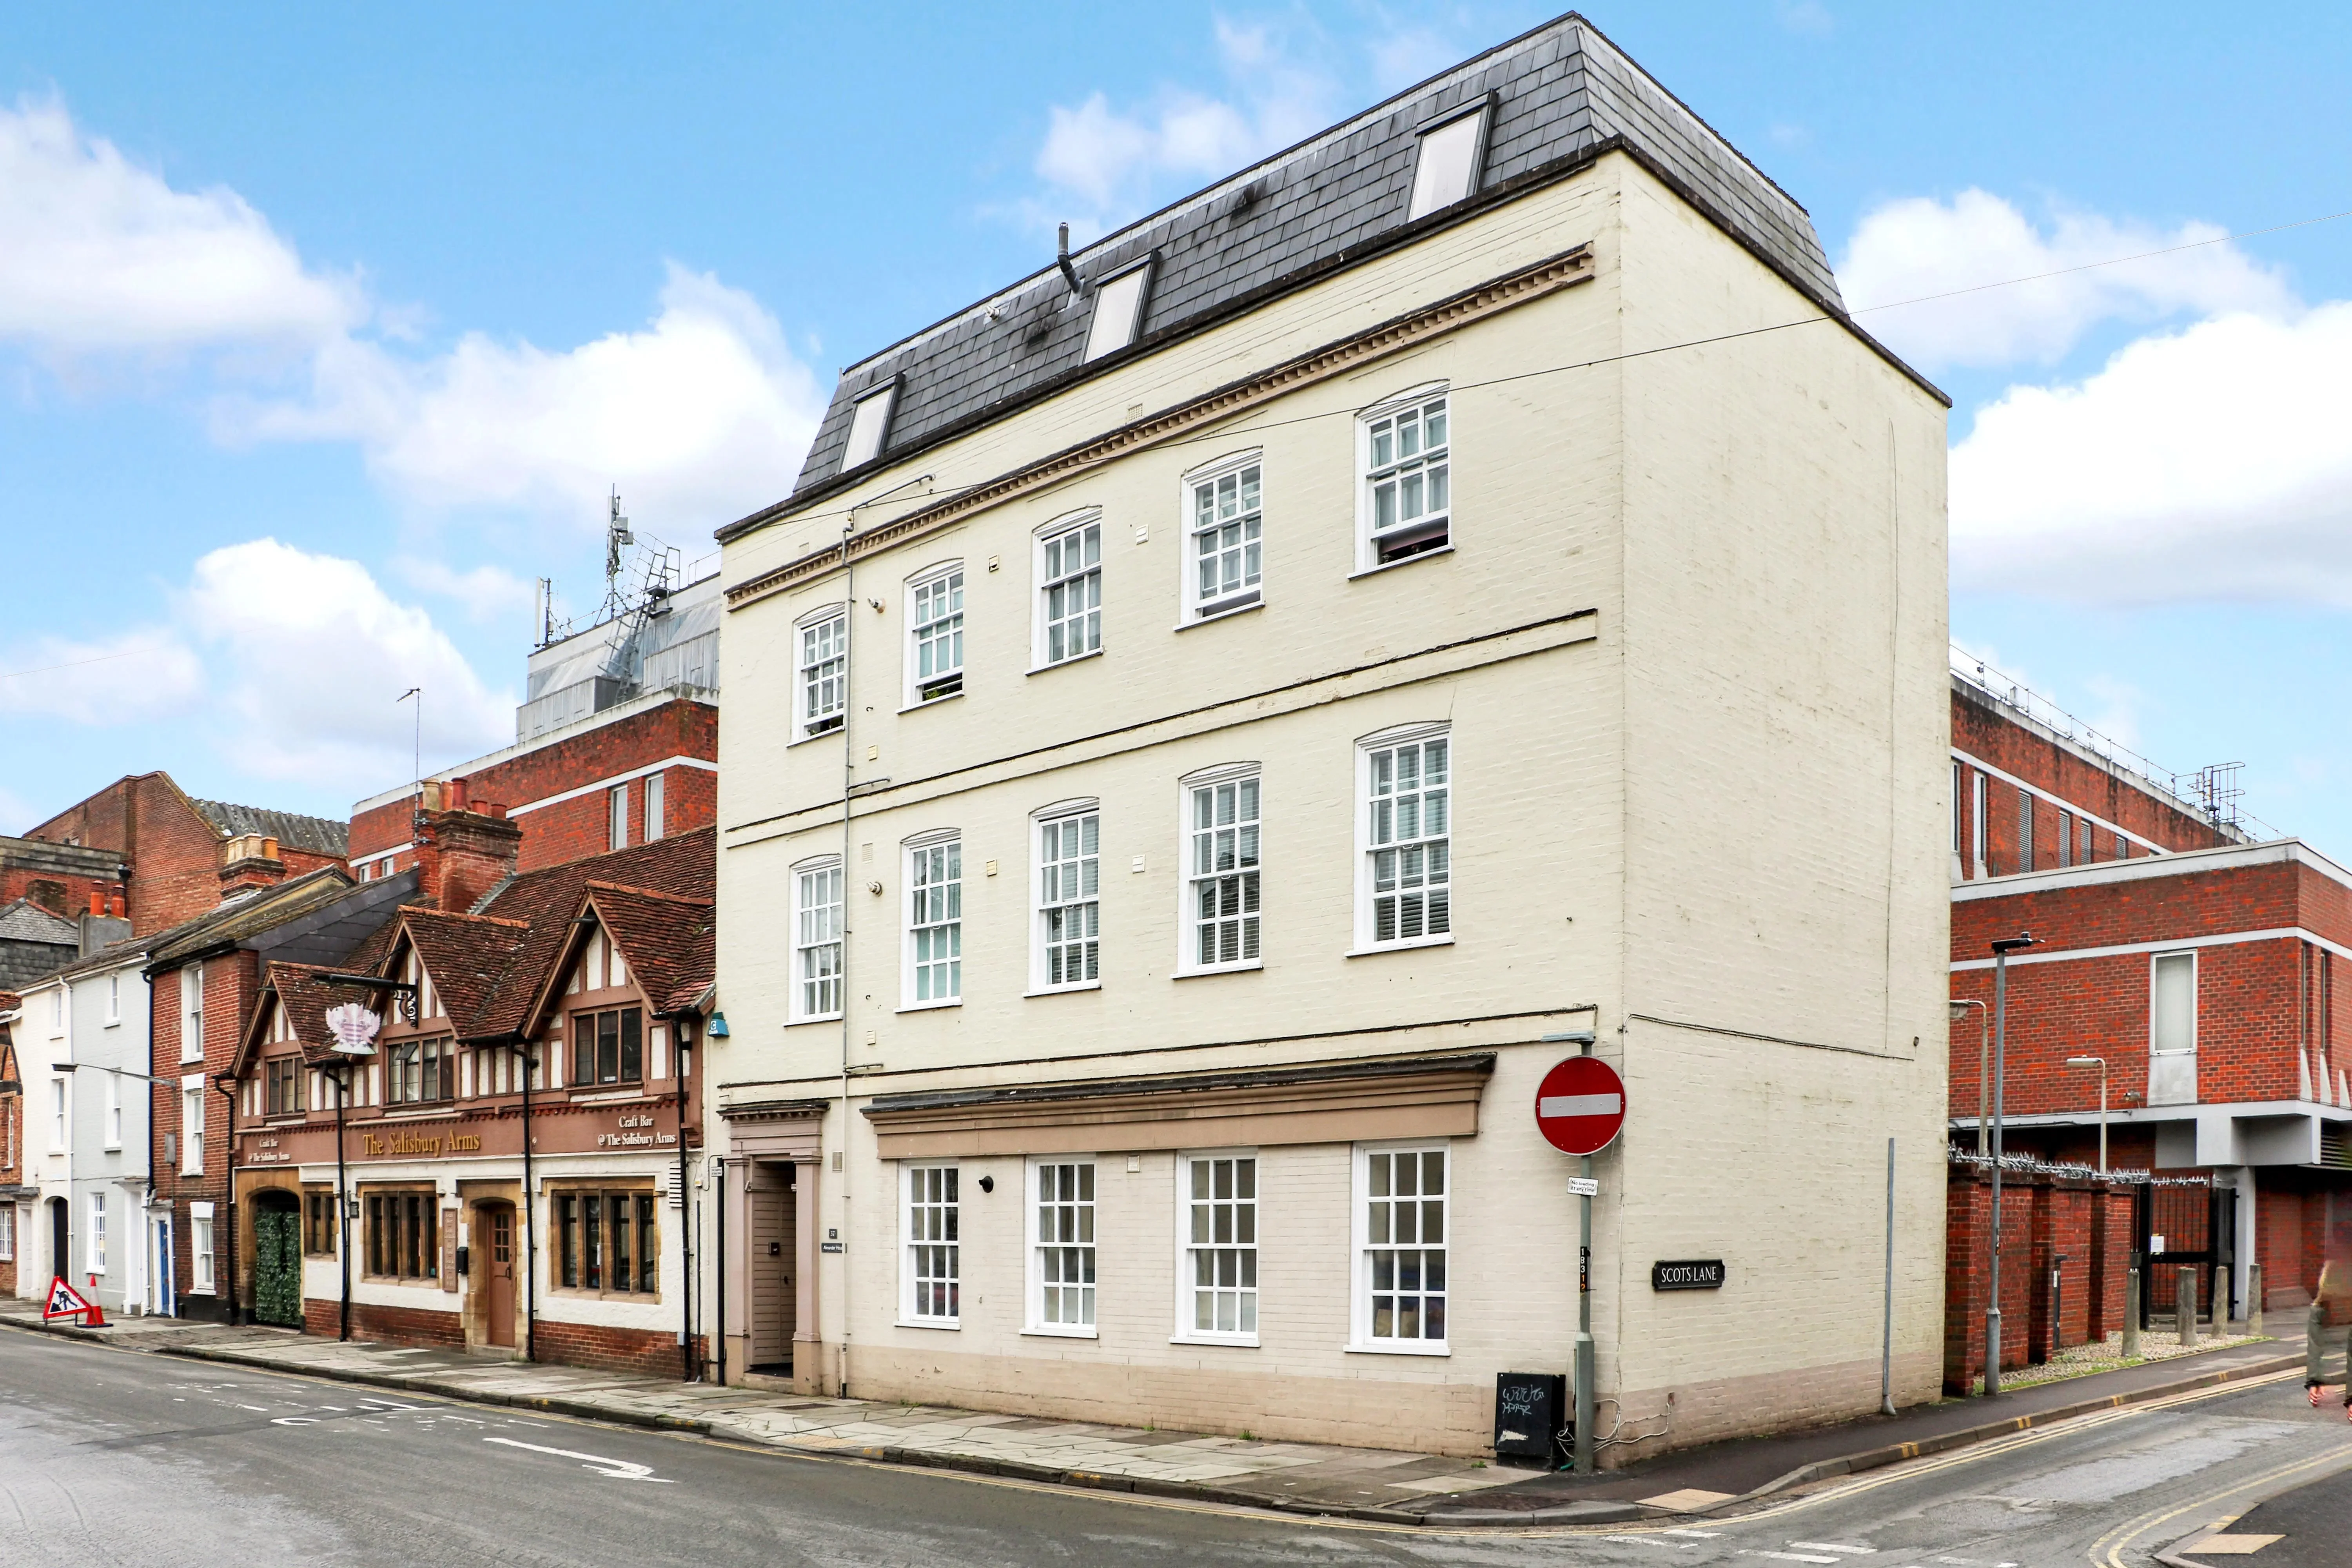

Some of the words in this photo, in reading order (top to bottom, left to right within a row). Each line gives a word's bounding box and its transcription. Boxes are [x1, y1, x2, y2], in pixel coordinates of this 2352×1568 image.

[619, 1115, 638, 1127] Craft
[640, 1115, 653, 1126] Bar
[363, 1133, 384, 1154] The
[389, 1131, 442, 1157] Salisbury
[446, 1129, 481, 1151] Arms
[598, 1134, 605, 1145] @
[606, 1133, 620, 1145] The
[622, 1132, 653, 1147] Salisbury
[655, 1132, 676, 1143] Arms
[1661, 1267, 1691, 1283] SCOTS
[1694, 1267, 1717, 1281] LANE
